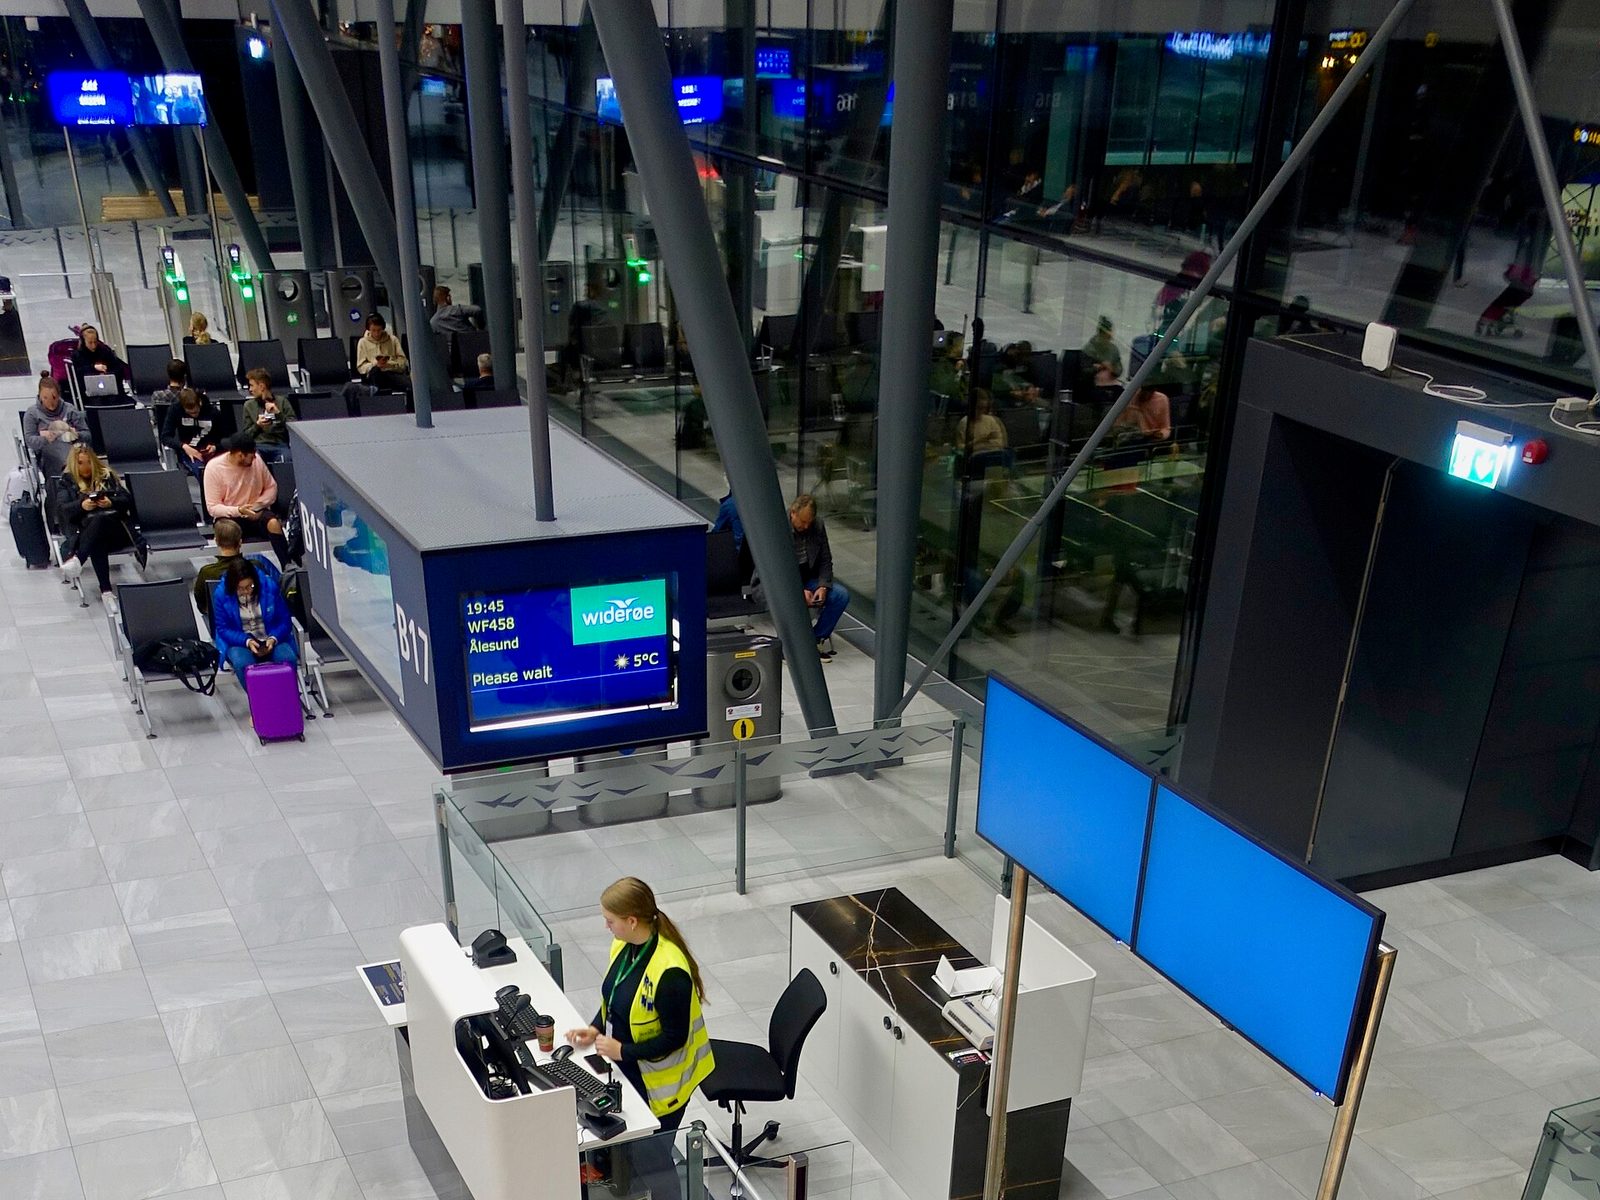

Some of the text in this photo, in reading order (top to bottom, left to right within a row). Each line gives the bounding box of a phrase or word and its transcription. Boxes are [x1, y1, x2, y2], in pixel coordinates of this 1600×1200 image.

[300, 502, 328, 570] B17
[466, 600, 504, 615] 19:45
[582, 605, 654, 626] widerøe
[468, 617, 515, 634] WF458
[396, 602, 429, 685] B17
[469, 637, 519, 654] Ålesund
[473, 665, 553, 687] Please wait
